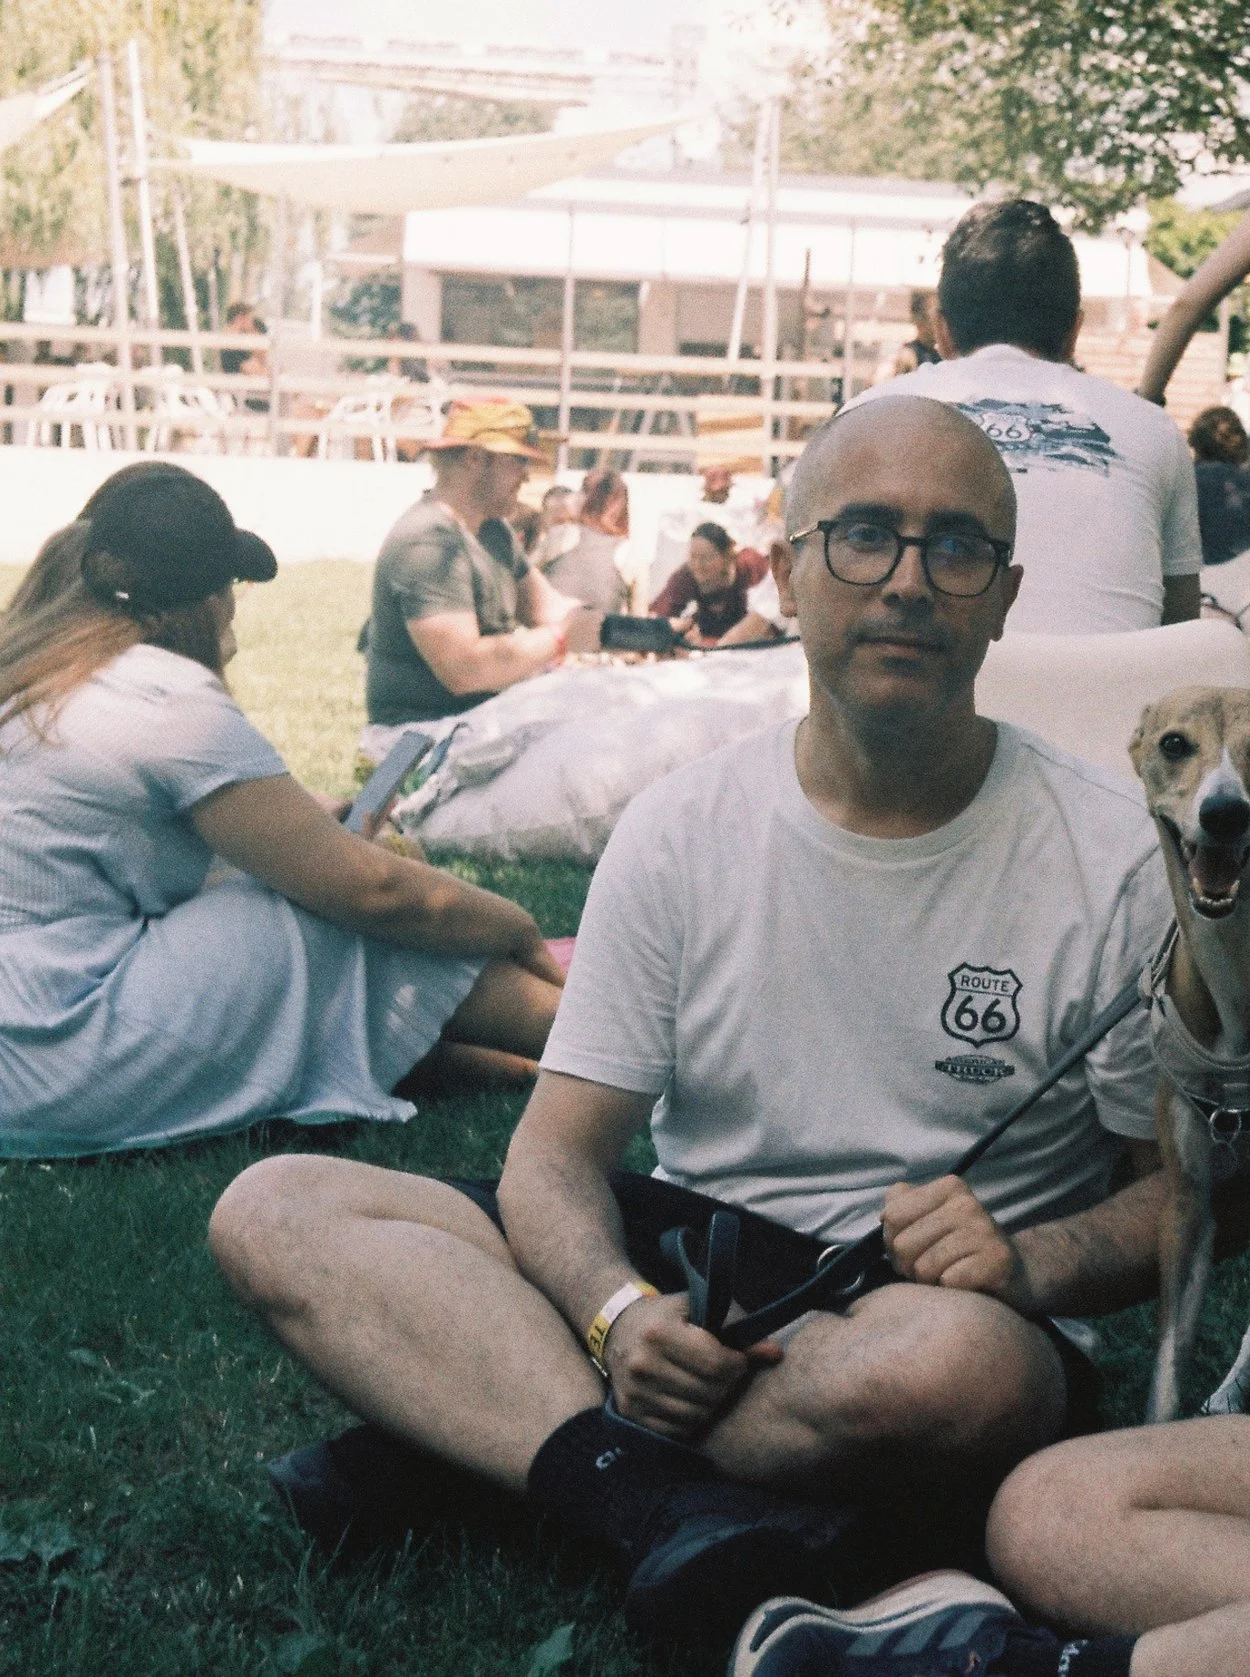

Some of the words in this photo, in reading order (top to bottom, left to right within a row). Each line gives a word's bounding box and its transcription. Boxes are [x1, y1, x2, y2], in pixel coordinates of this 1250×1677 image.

[986, 423, 1022, 439] 66
[961, 975, 1009, 992] ROUTE
[954, 995, 1006, 1034] 66
